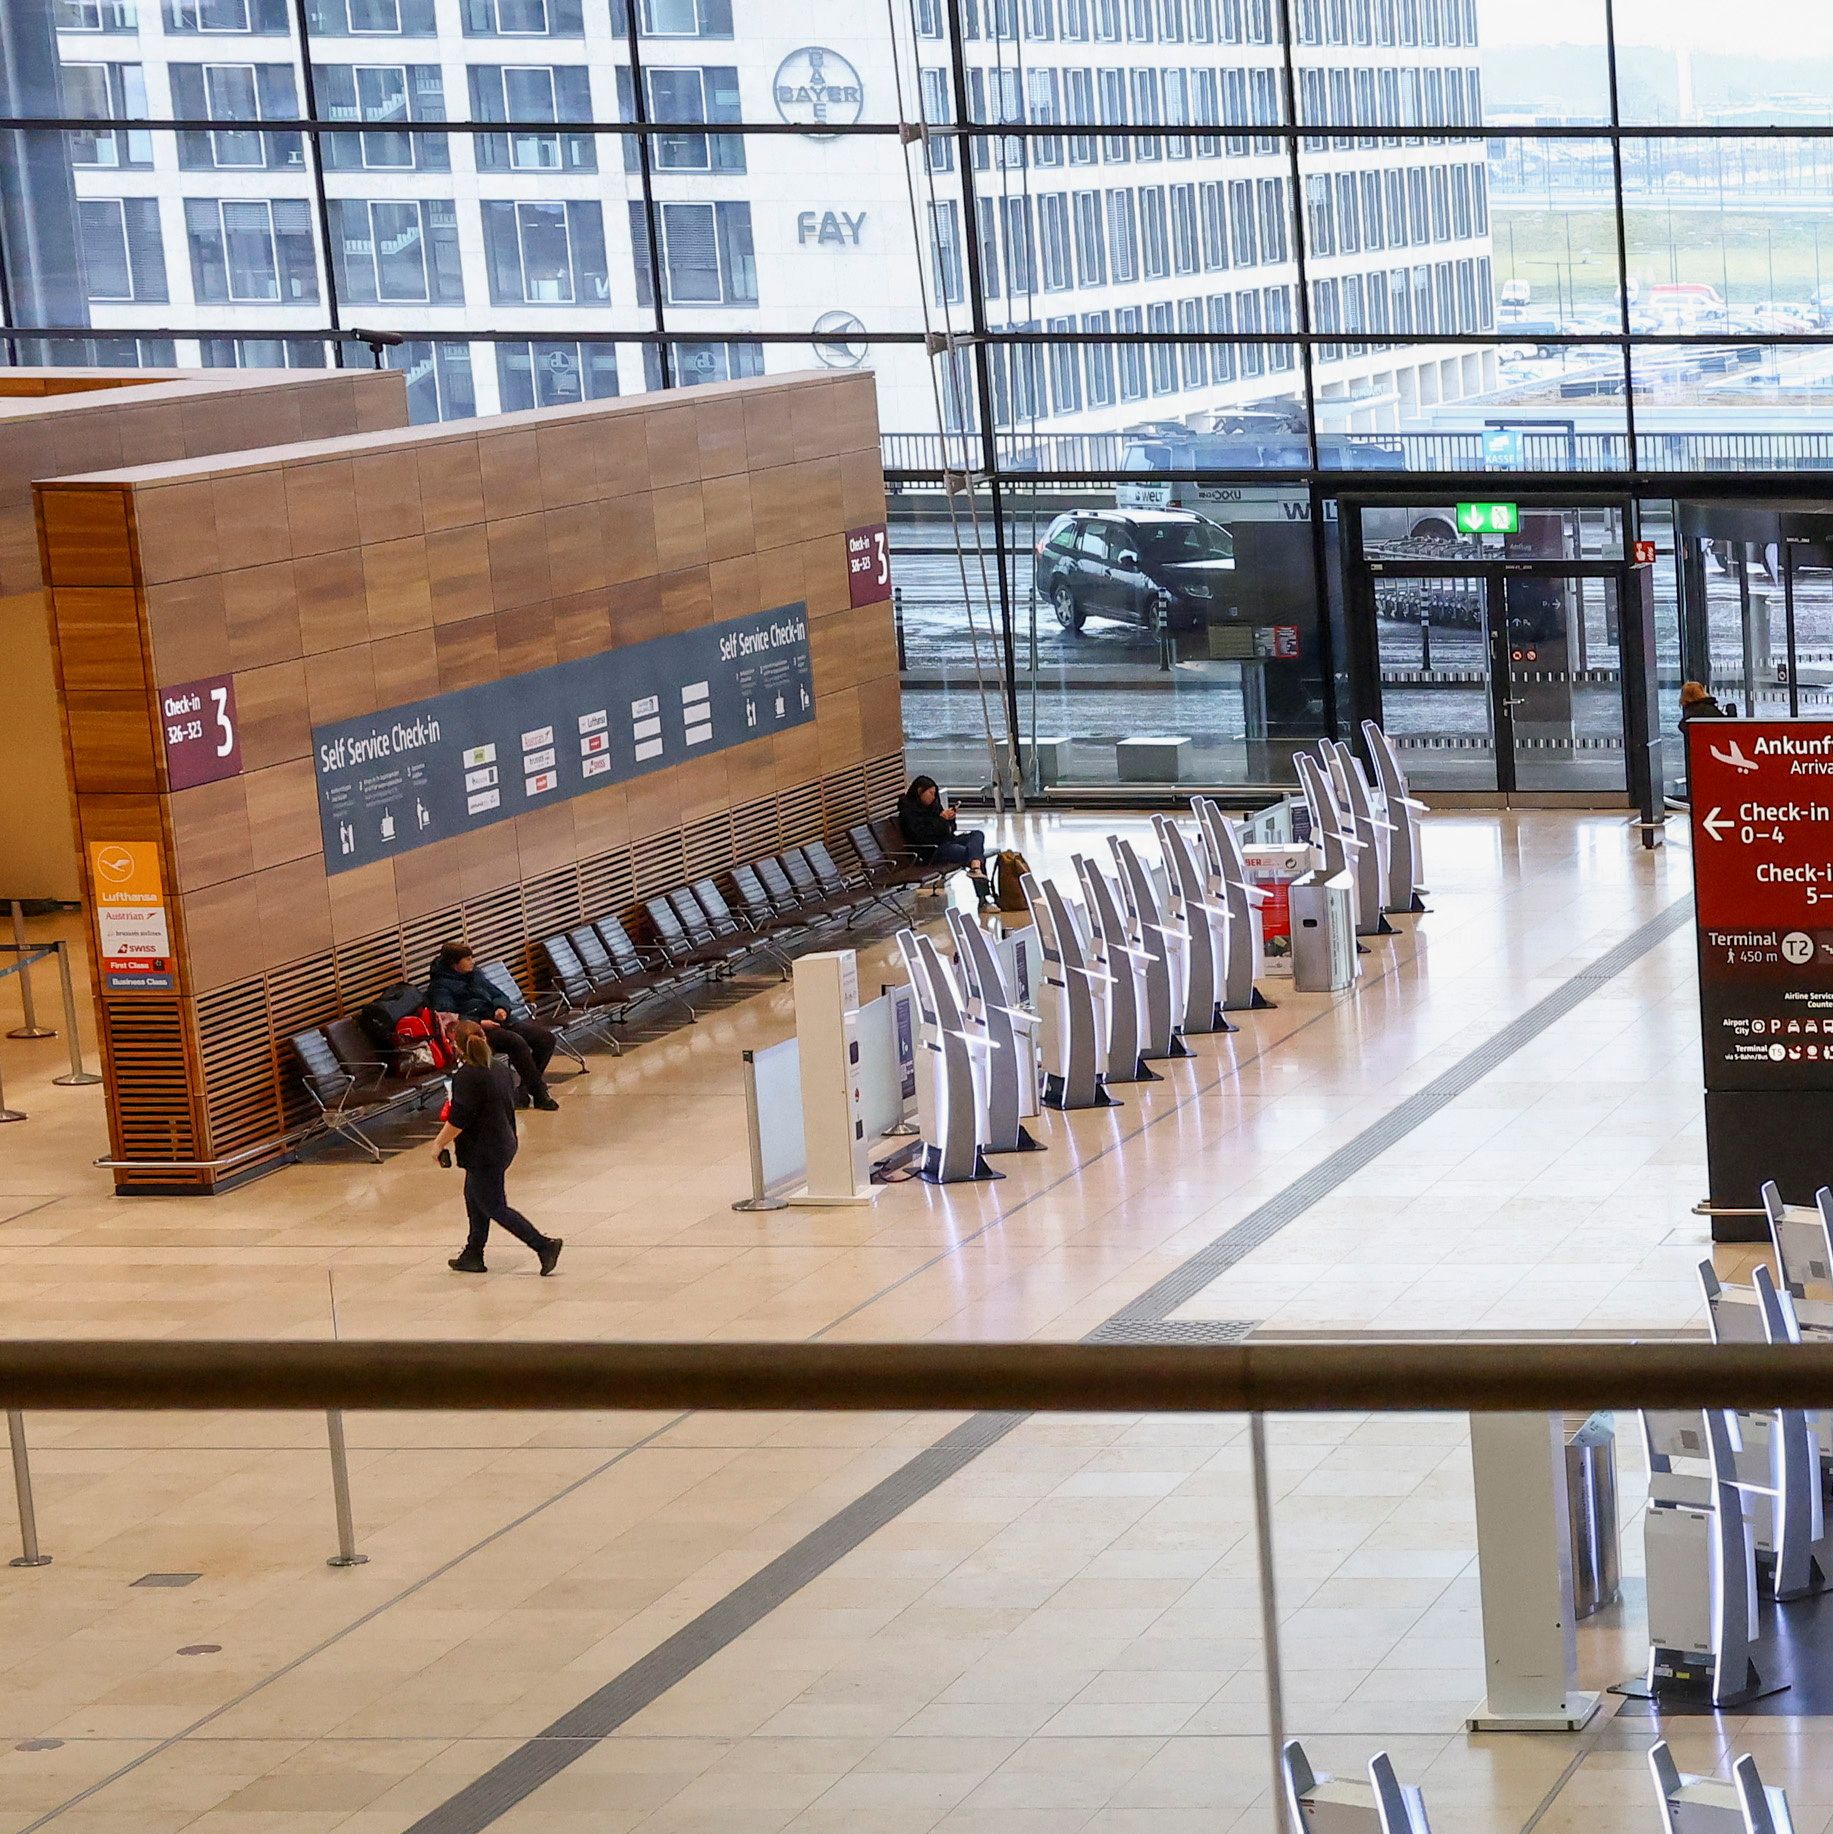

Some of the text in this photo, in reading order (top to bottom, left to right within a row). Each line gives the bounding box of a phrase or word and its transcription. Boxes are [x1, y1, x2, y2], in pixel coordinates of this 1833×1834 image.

[778, 86, 860, 103] BAYER
[797, 211, 867, 245] FAY
[849, 535, 870, 552] Check-in
[874, 532, 888, 585] 3
[719, 617, 806, 661] Self Service Check-in
[165, 692, 201, 717] Check-in
[210, 687, 233, 757] 3
[320, 715, 441, 772] Self Service Check-in
[1739, 802, 1830, 821] Check-in
[102, 891, 158, 902] Lufthansa
[105, 911, 145, 920] Austrian
[1708, 931, 1777, 946] Terminal
[1786, 940, 1809, 956] T2
[1740, 950, 1778, 963] 450 m
[1784, 992, 1809, 1000] Airline
[1722, 1018, 1750, 1027] Airport
[1734, 1026, 1750, 1036] City
[1735, 1044, 1767, 1053] Terminal
